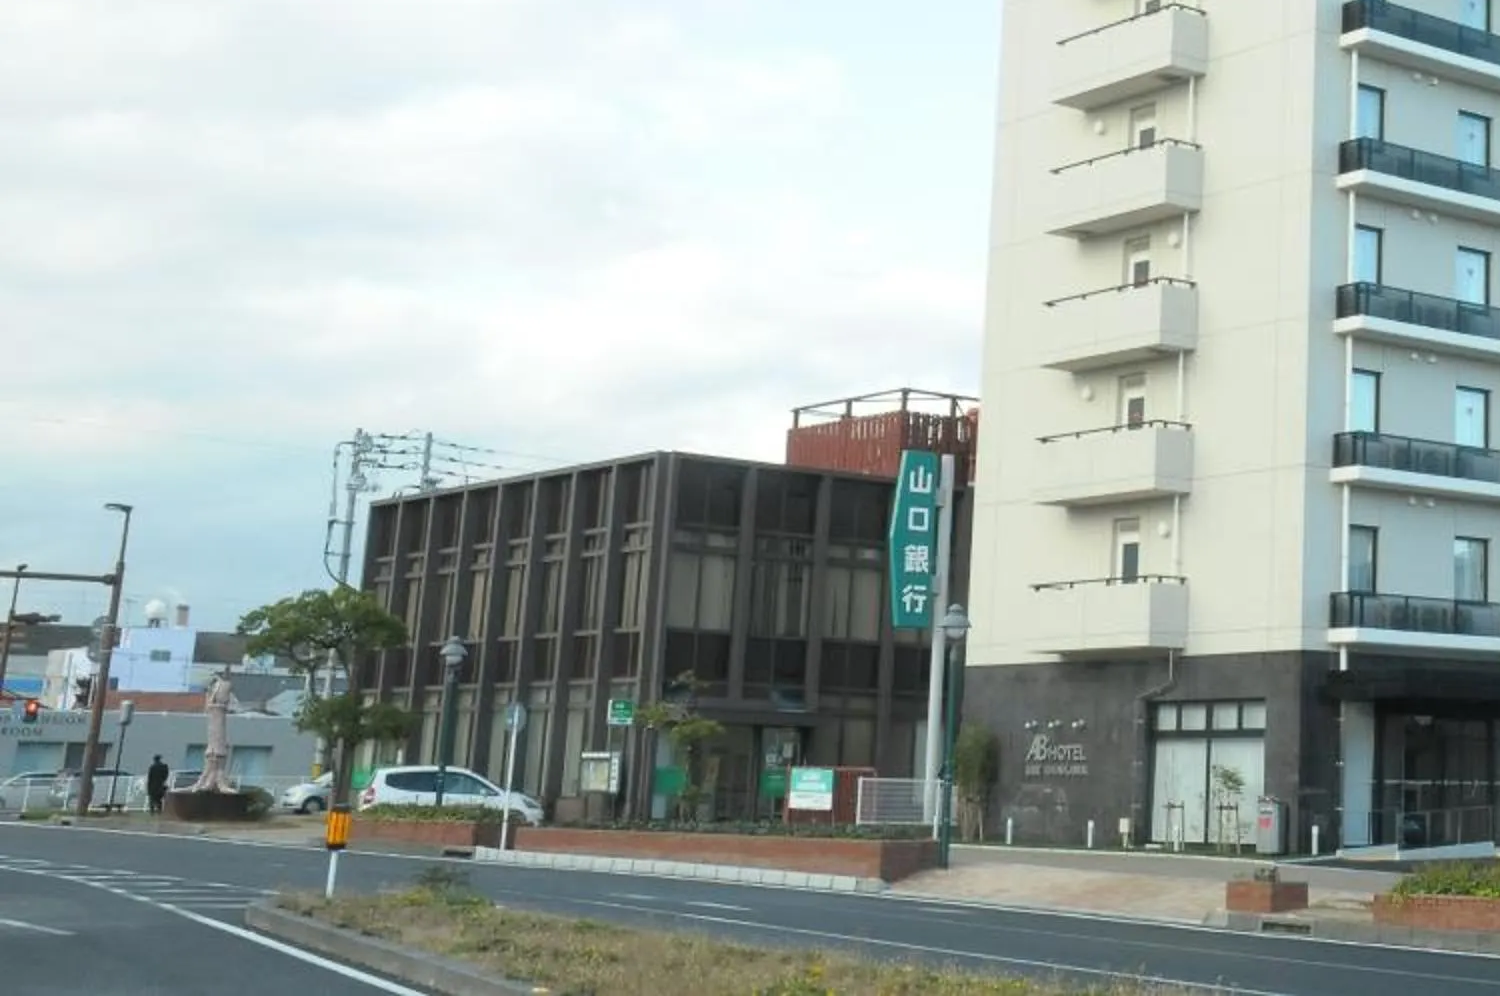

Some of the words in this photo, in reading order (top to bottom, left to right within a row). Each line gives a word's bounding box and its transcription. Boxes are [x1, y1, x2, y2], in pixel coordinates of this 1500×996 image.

[901, 465, 933, 614] 山口銀行
[1024, 734, 1047, 761] AB
[1047, 744, 1087, 761] HOTEL
